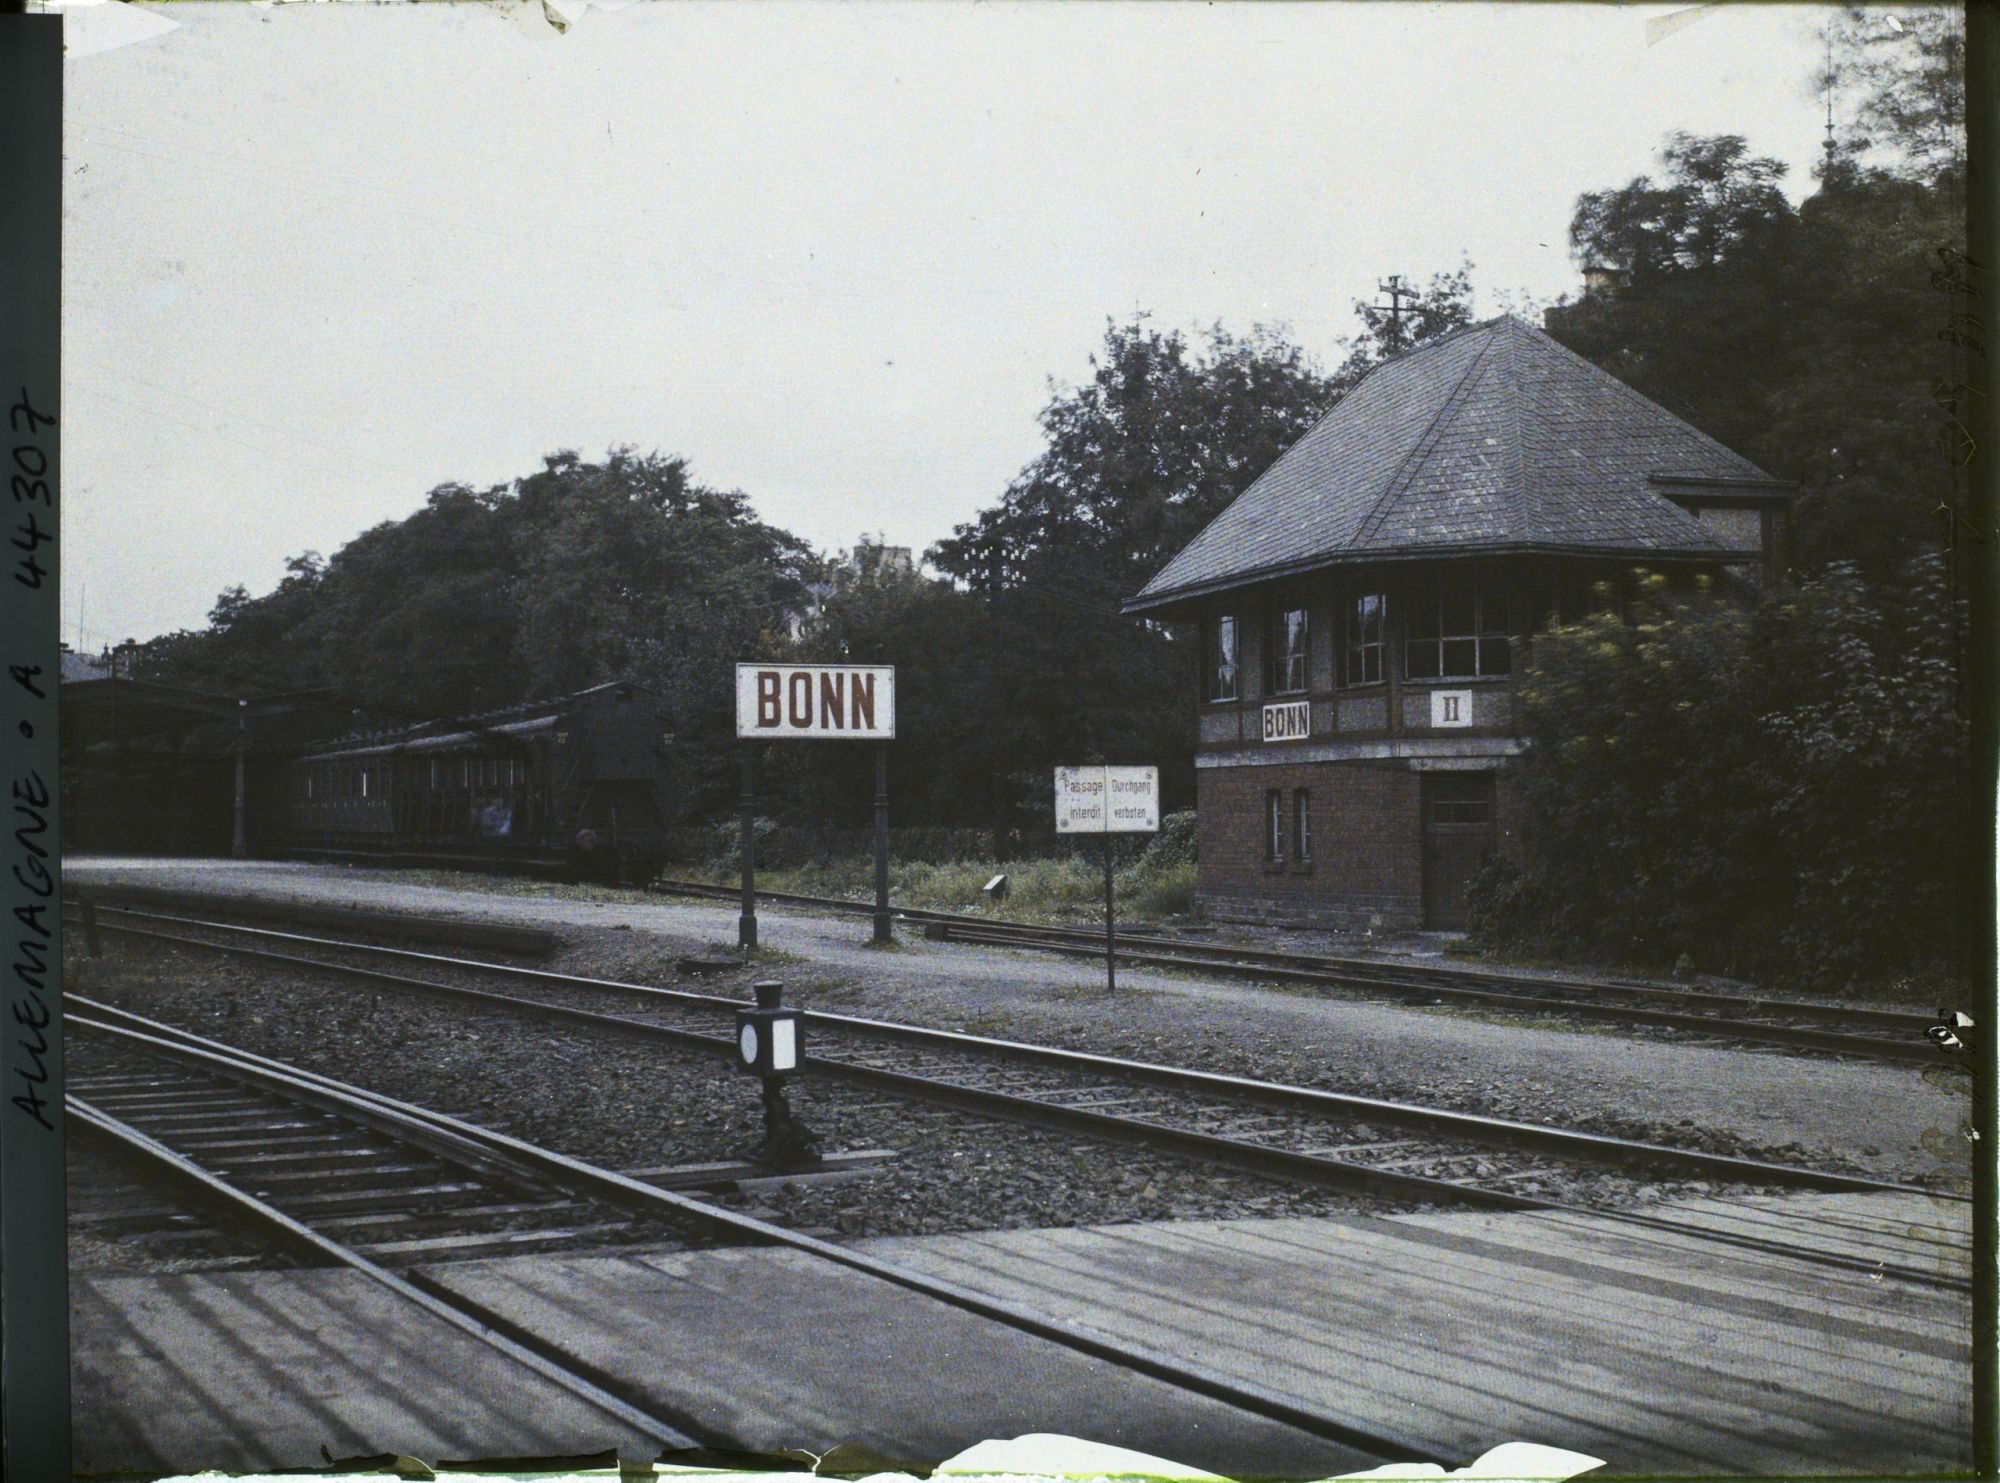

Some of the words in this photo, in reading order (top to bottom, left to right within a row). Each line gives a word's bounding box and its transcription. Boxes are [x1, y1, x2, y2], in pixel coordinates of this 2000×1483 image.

[9, 386, 57, 590] 44307
[757, 671, 875, 730] BONN
[1264, 704, 1308, 738] BONN
[1064, 779, 1103, 796] Passage
[1111, 779, 1151, 795] Durchgang
[1070, 804, 1101, 819] interdit
[1114, 805, 1146, 819] verboten
[10, 769, 55, 1132] ALLEMAGNE
